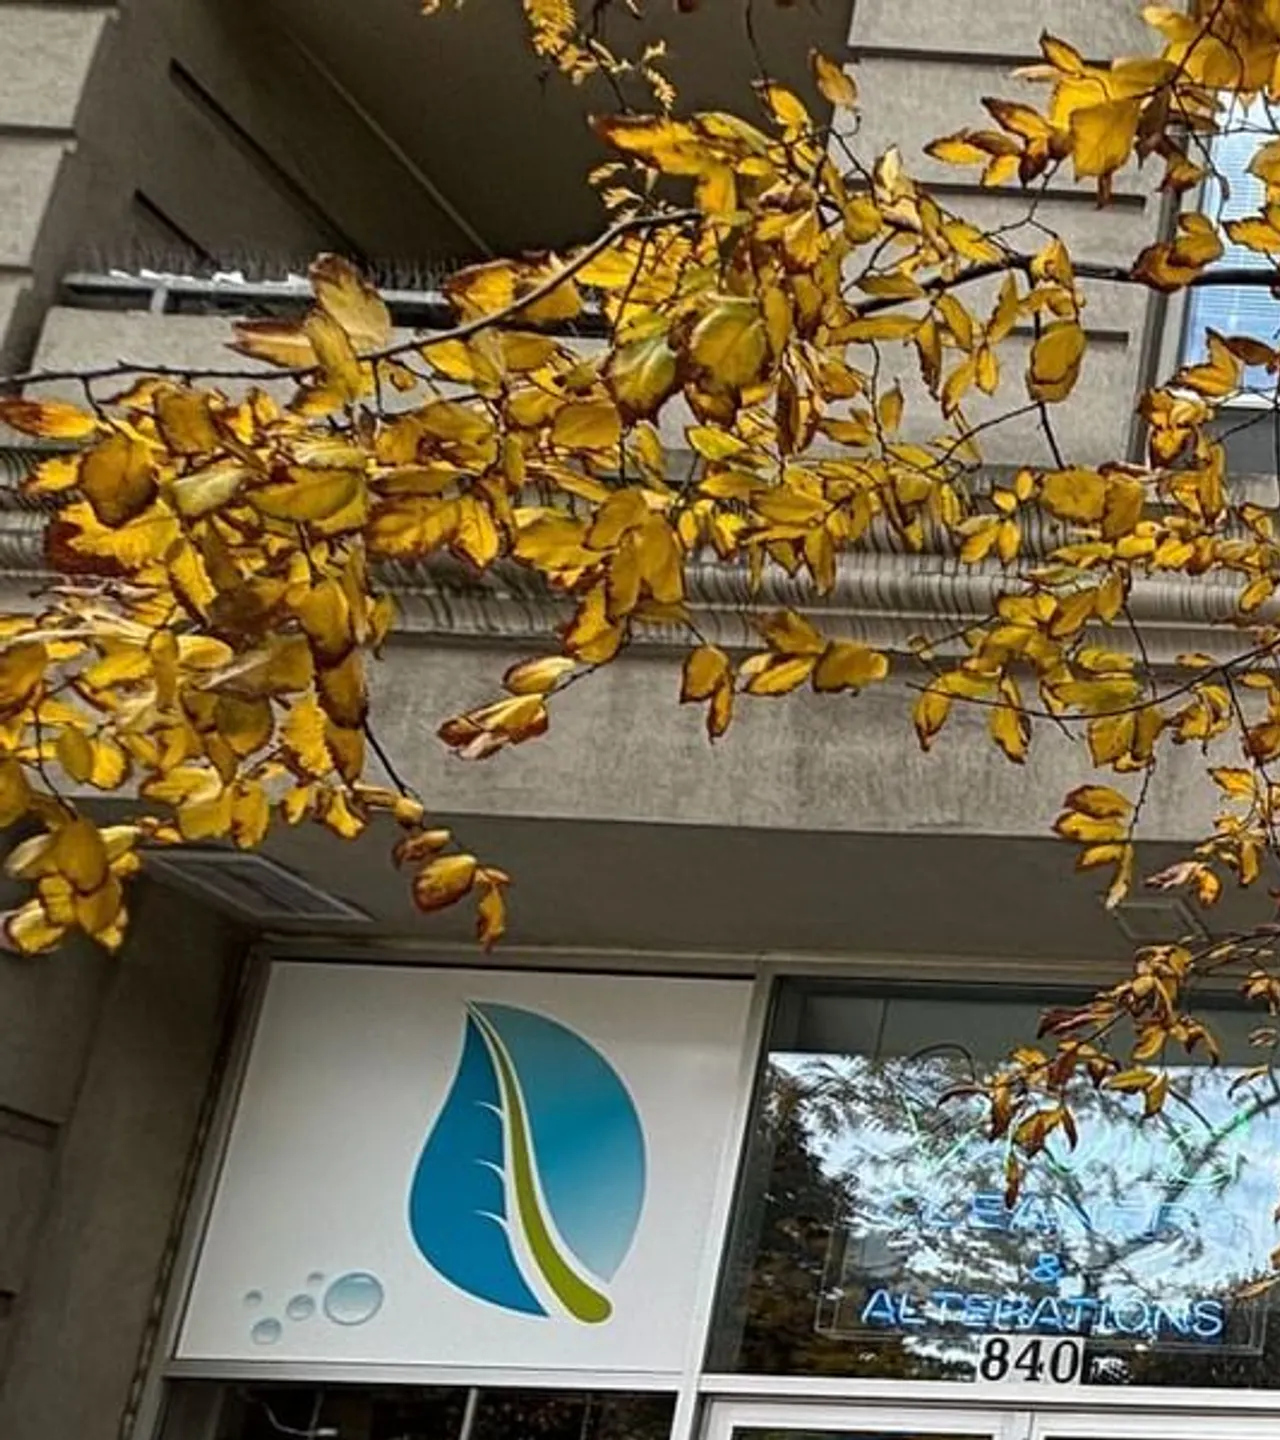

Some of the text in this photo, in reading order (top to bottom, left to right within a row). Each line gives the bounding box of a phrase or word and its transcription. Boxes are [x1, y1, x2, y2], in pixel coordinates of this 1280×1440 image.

[1032, 1253, 1065, 1284] &
[861, 1289, 1225, 1337] ALTERATIONS
[979, 1338, 1081, 1384] 840
